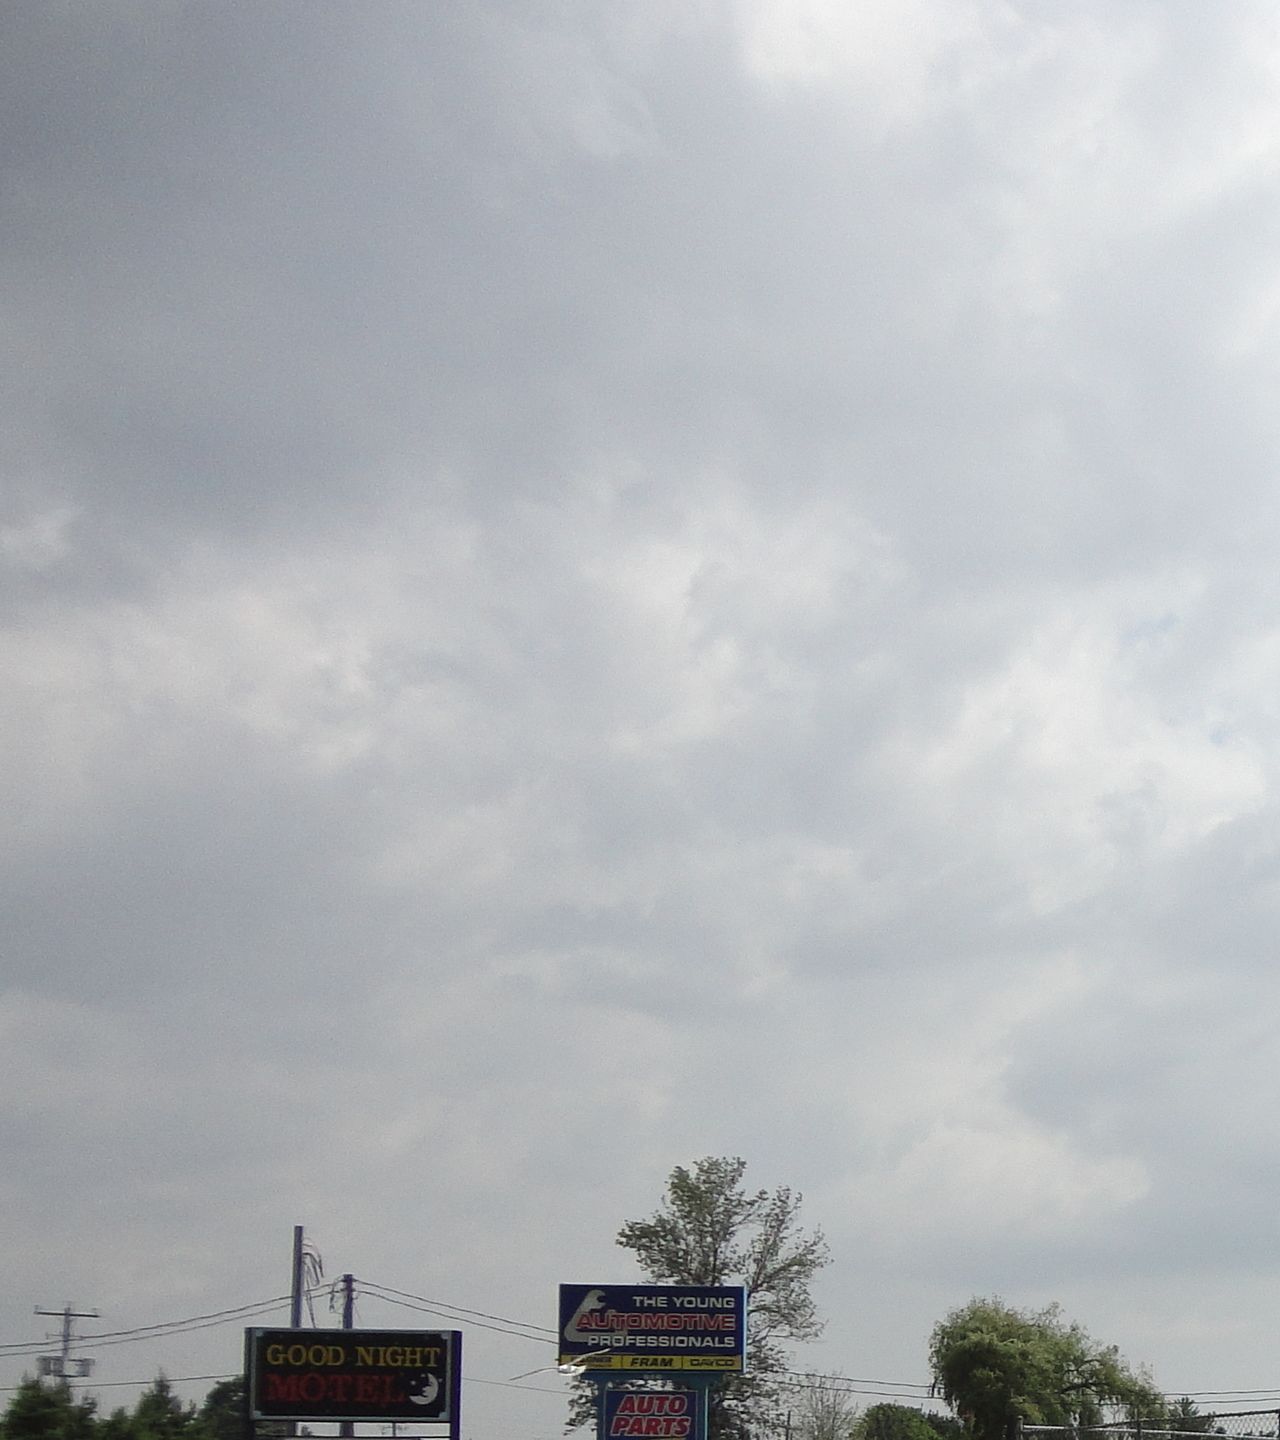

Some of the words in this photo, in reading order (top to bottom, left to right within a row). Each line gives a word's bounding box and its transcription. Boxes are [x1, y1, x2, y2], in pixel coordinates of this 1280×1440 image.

[632, 1296, 668, 1307] THE
[673, 1297, 735, 1308] YOUNG
[576, 1312, 736, 1330] AUTOMOTIVE
[587, 1335, 735, 1348] PROFESSIONALS
[266, 1345, 345, 1366] GOOD
[355, 1346, 440, 1367] NIGHT
[630, 1358, 673, 1367] FRAM
[690, 1359, 734, 1367] DAYCO
[265, 1373, 407, 1404] MOTEL
[616, 1394, 688, 1415] AUTO
[610, 1416, 692, 1436] PARTS
